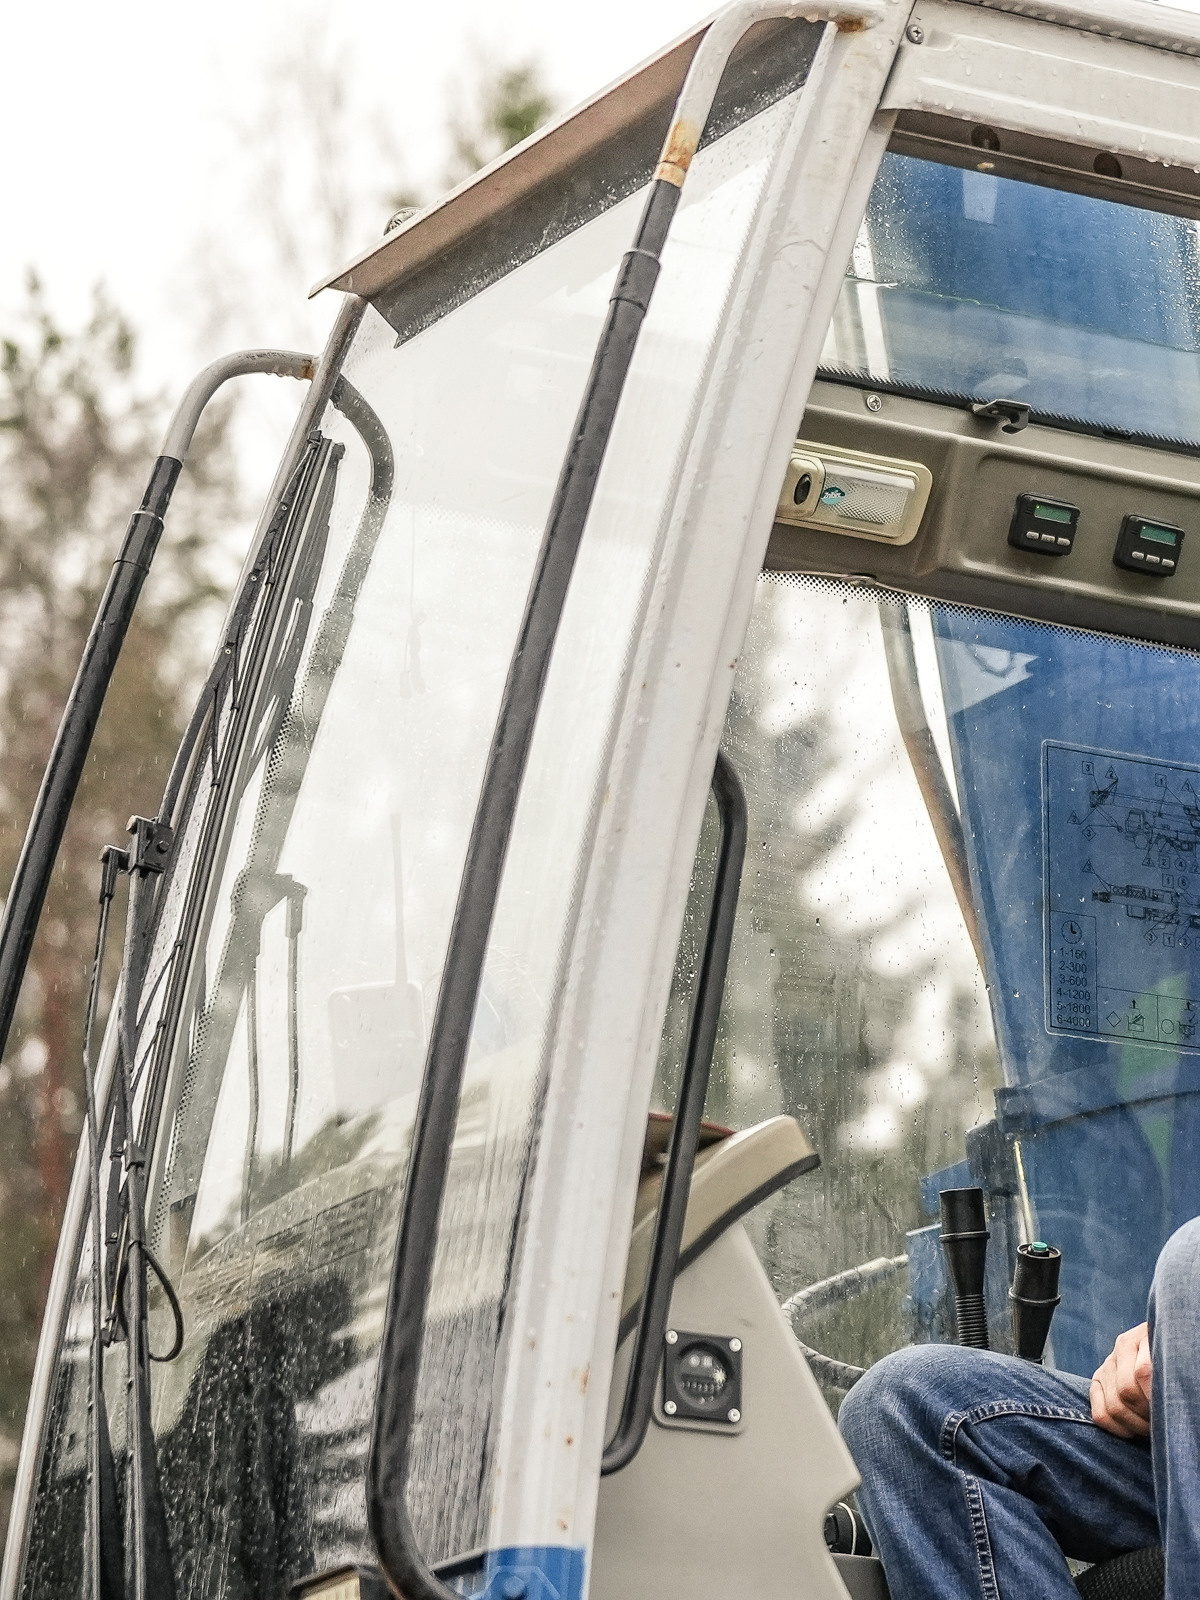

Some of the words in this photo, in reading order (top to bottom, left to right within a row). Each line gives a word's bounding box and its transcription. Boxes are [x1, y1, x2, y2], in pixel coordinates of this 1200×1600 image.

[1059, 960, 1087, 974] 2-300
[1059, 973, 1087, 987] 3-600
[1056, 988, 1091, 1001] 4-1200
[1056, 1001, 1091, 1015] 5-1800
[1056, 1014, 1091, 1028] 6-4000
